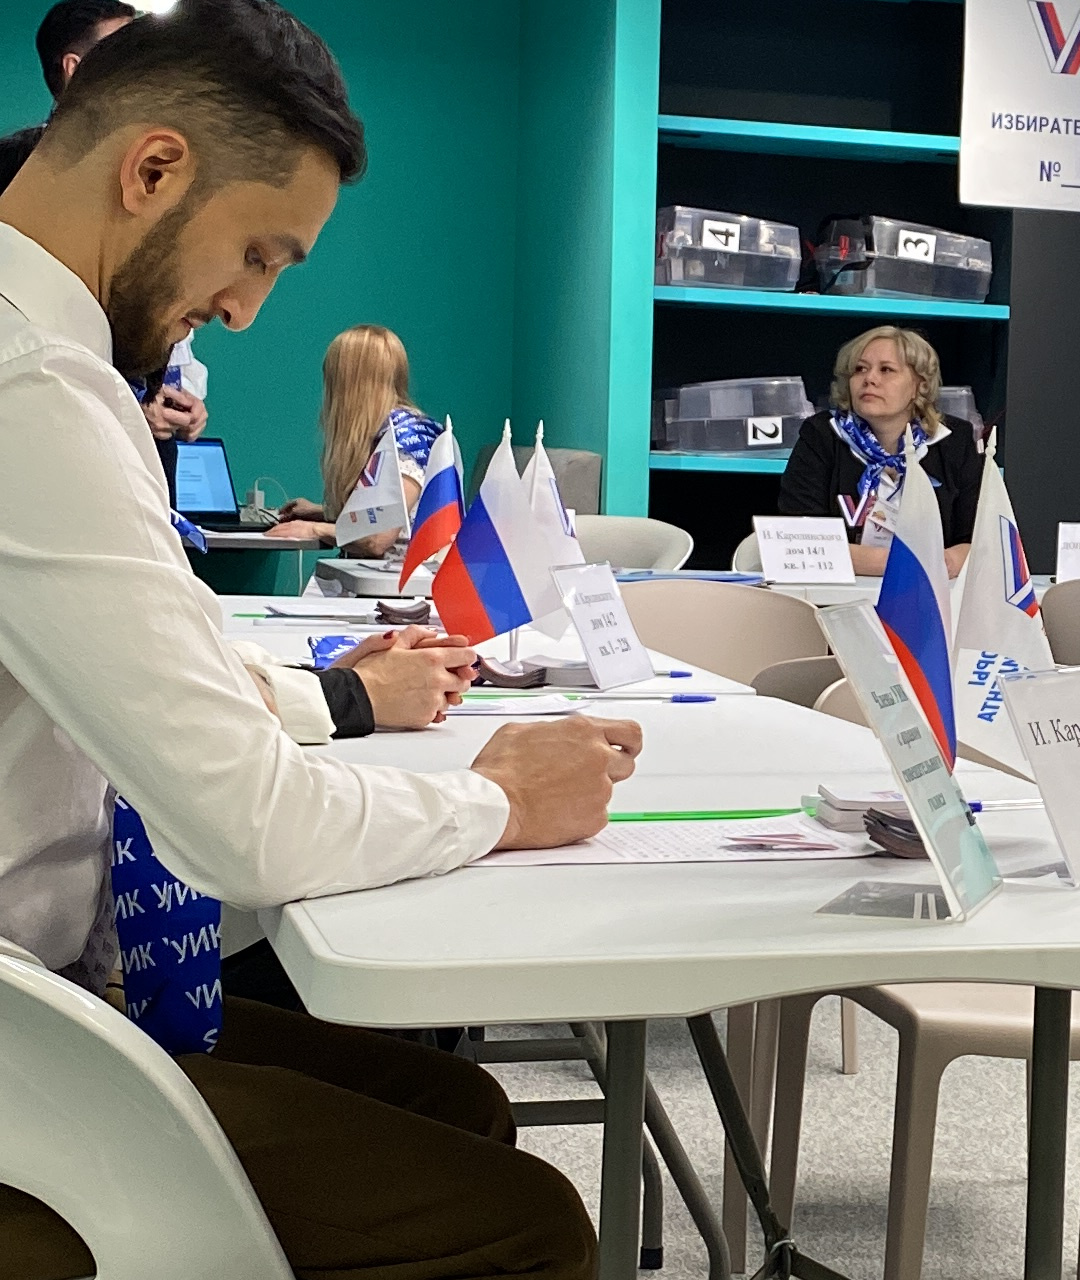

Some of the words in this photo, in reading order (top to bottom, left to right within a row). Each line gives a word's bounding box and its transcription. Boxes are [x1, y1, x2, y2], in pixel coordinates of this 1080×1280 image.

[1039, 160, 1062, 182] №
[708, 228, 736, 247] 4
[903, 237, 930, 257] 3
[752, 422, 780, 441] 2
[1028, 721, 1052, 746] И.
